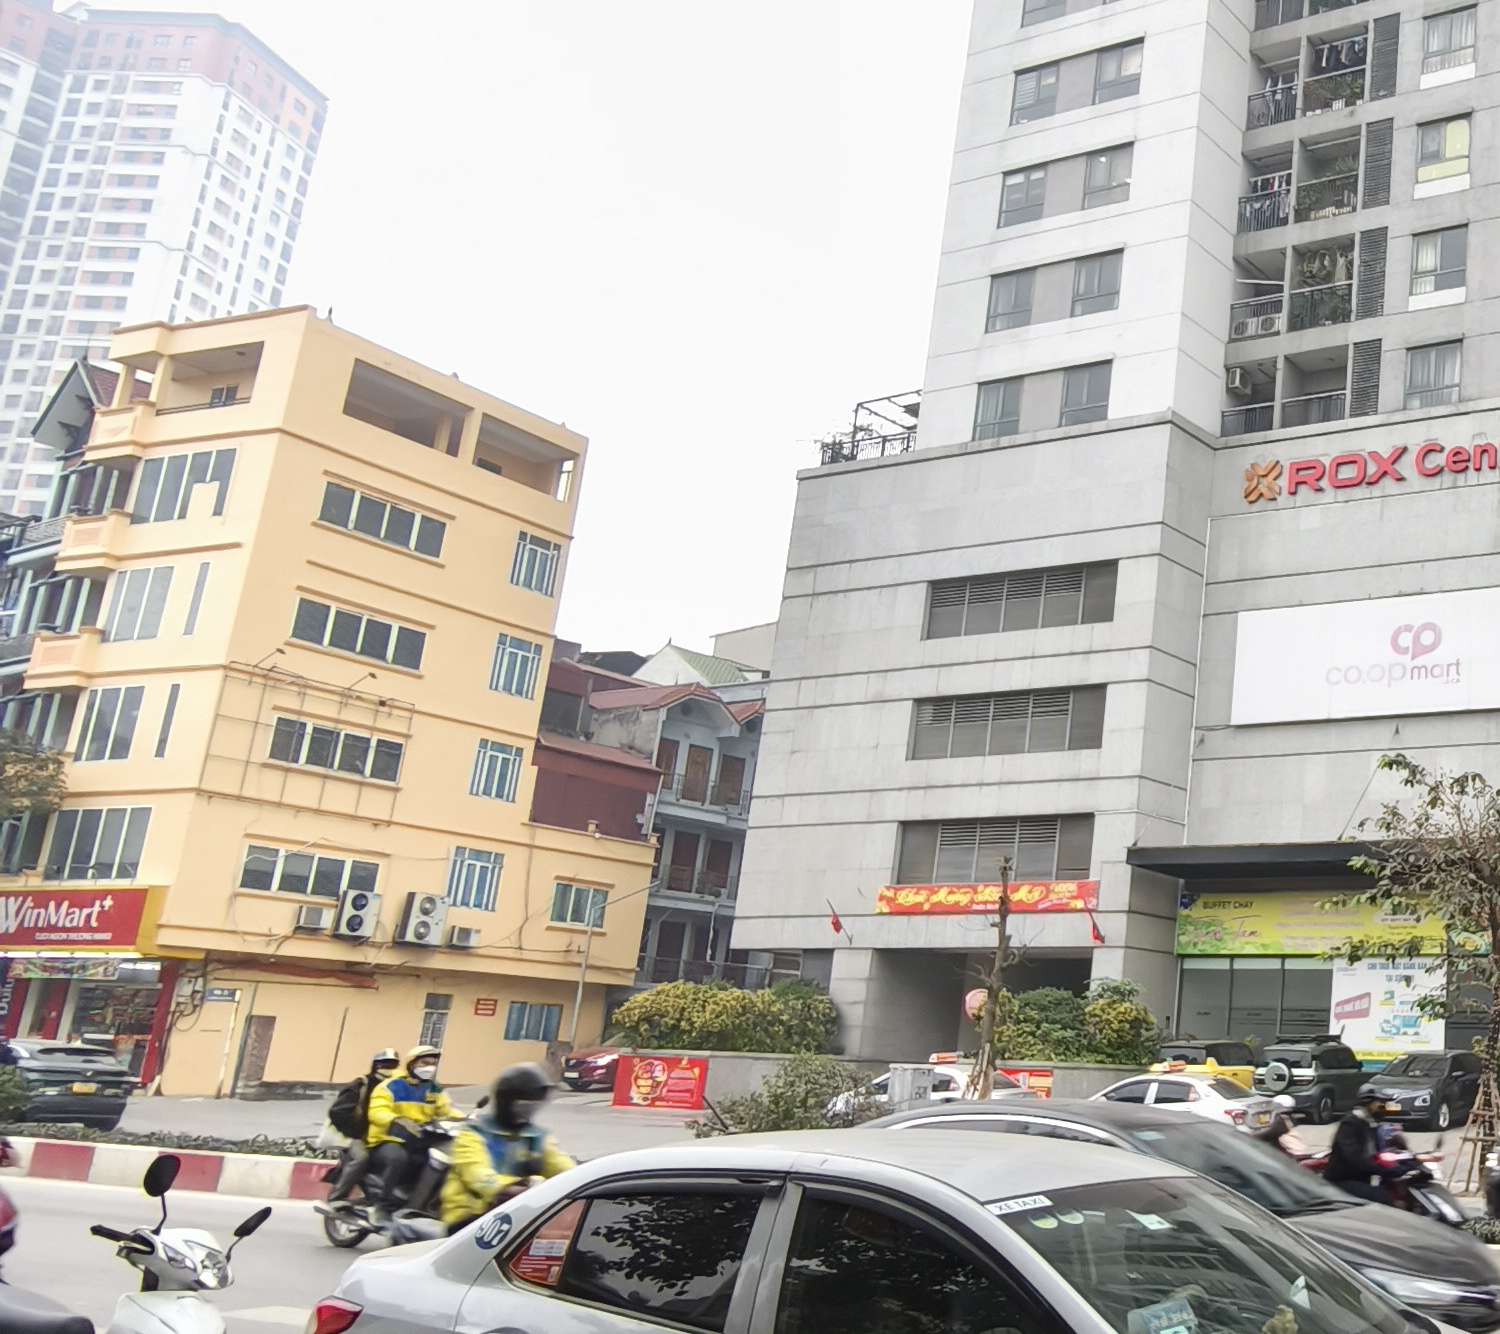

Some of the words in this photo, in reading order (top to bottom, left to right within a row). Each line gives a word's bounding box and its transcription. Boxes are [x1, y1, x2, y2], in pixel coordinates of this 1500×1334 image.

[1287, 446, 1407, 495] ROX
[1203, 900, 1232, 909] BUFFET
[994, 1203, 1014, 1212] XE
[1014, 1197, 1045, 1208] TAXI
[477, 1217, 511, 1247] 907
